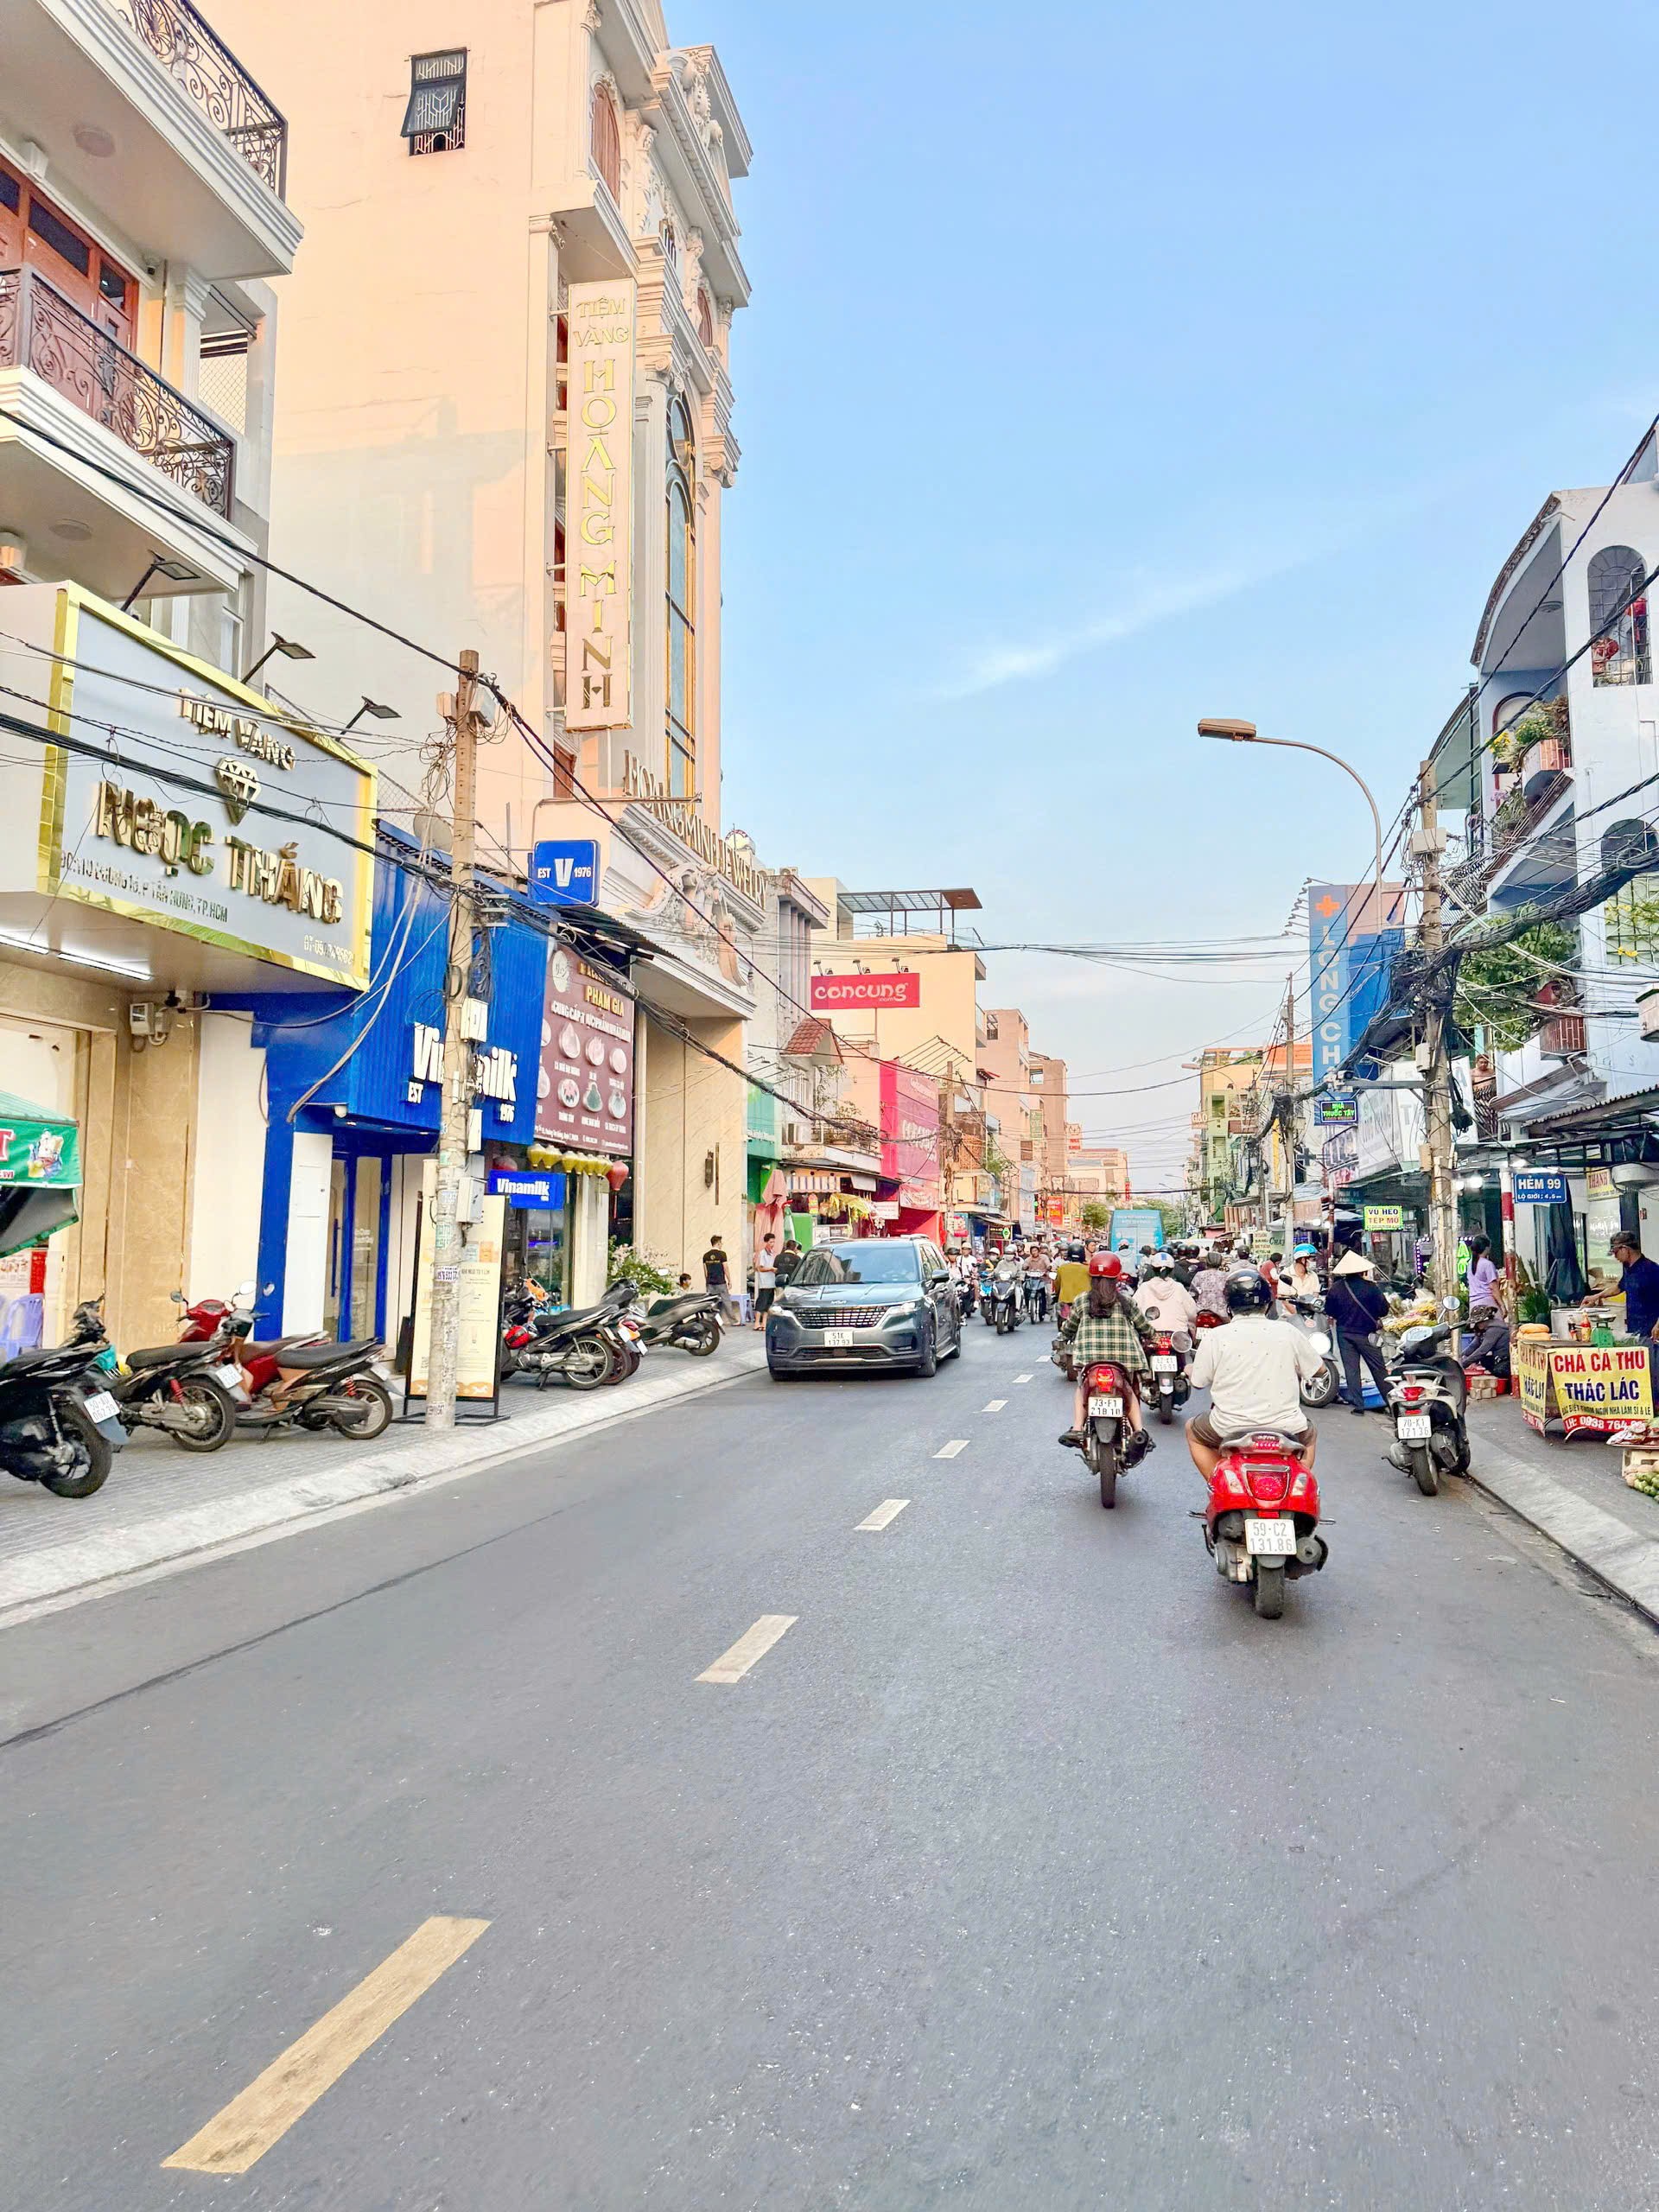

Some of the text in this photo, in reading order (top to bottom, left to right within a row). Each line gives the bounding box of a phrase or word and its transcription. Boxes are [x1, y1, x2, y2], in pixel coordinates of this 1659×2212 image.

[576, 295, 626, 320] TIỆM
[573, 322, 629, 347] VÀNG
[579, 560, 617, 711] MINH
[234, 718, 296, 771] VÀNG
[97, 779, 344, 925] NGỌC THẮNG
[537, 868, 551, 879] EST
[574, 866, 592, 878] 1976
[1318, 925, 1341, 1015] LONG
[814, 982, 908, 1002] concung
[610, 997, 625, 1018] GIA
[497, 1178, 550, 1196] Vinamilk
[1518, 1175, 1561, 1190] HẺM 99
[1554, 1348, 1586, 1373] CHẢ
[1591, 1348, 1612, 1372] CÁ
[1616, 1350, 1645, 1370] THU
[1564, 1378, 1605, 1402] THÁC
[1610, 1376, 1640, 1401] LÁC
[1565, 1417, 1578, 1430] LH:
[1580, 1416, 1605, 1430] 0938
[1607, 1420, 1628, 1430] 764
[1249, 1538, 1293, 1553] 131.86
